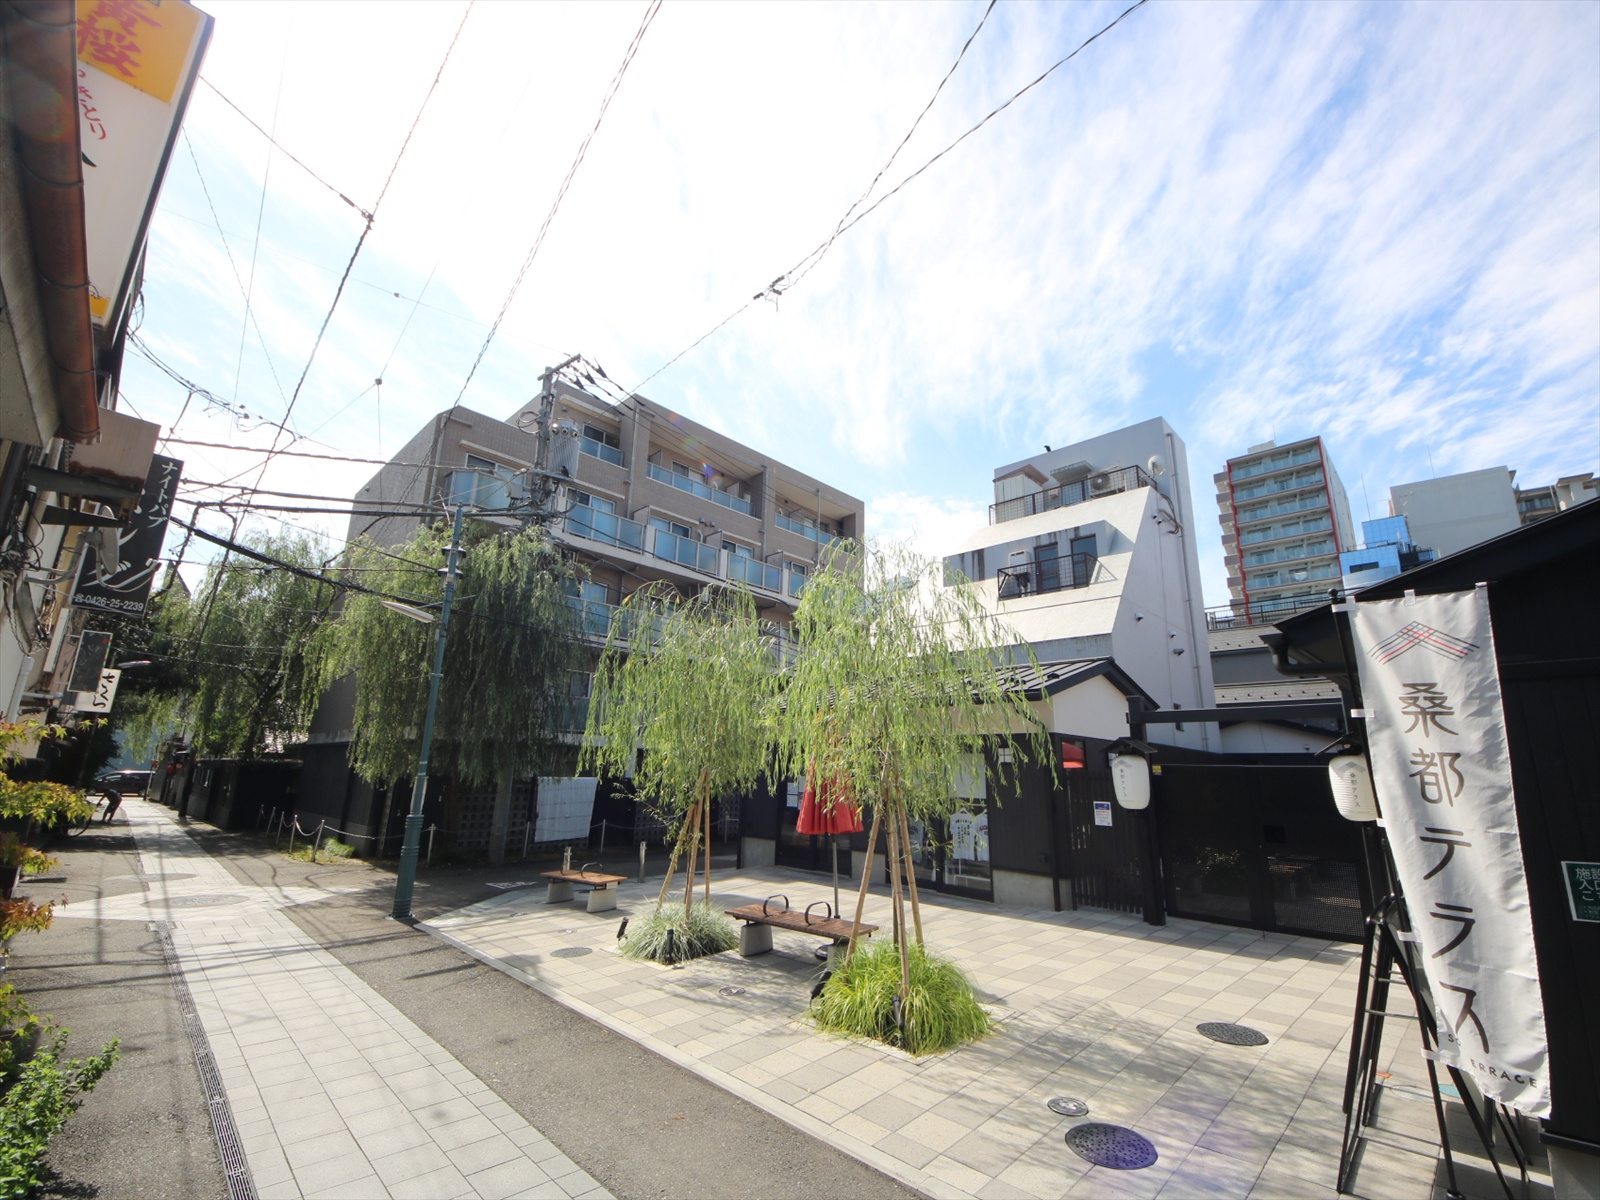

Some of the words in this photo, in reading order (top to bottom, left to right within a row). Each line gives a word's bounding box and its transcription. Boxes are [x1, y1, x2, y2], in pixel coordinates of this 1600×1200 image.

[147, 461, 178, 529] ナイトパブ
[92, 672, 116, 709] さくら
[1398, 682, 1490, 1055] 桑都テラス
